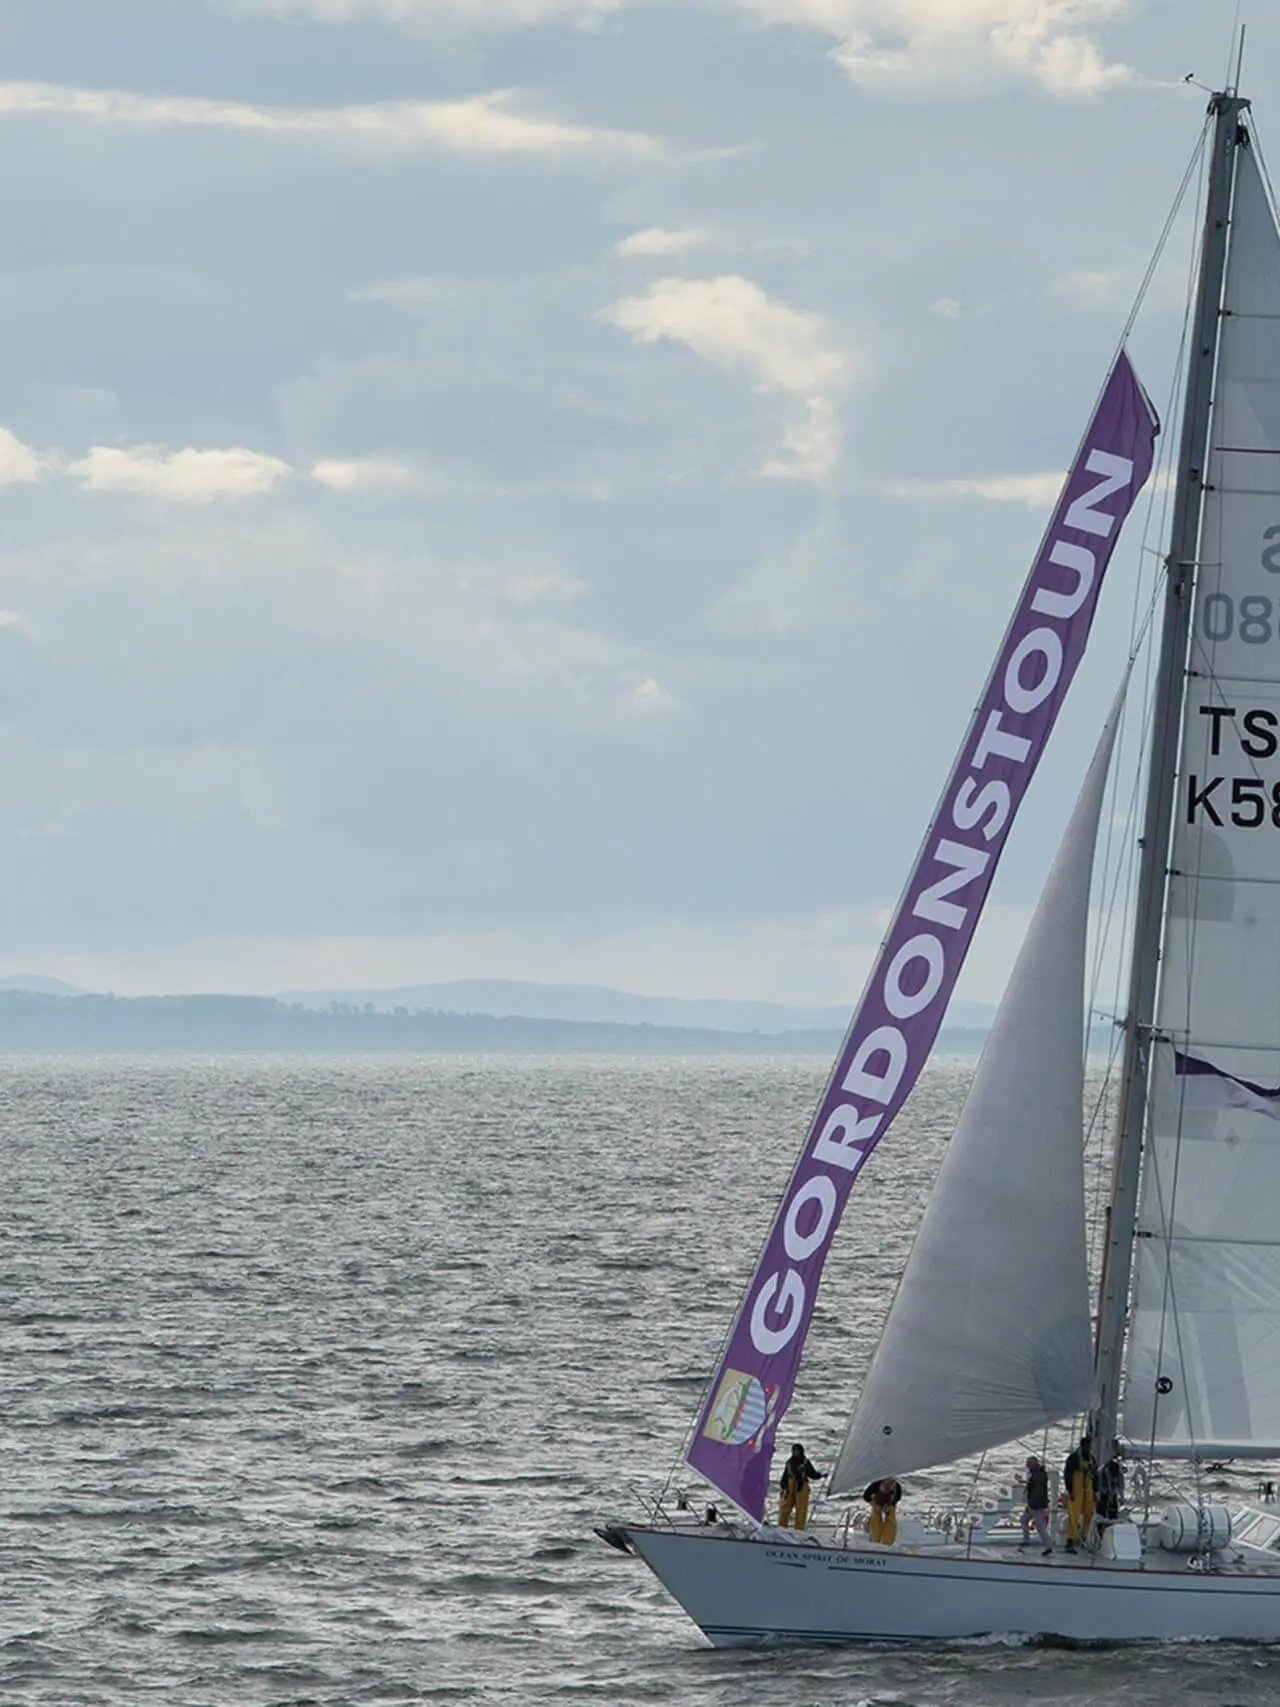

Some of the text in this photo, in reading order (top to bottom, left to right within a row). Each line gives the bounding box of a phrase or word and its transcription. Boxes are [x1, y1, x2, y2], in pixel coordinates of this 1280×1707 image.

[1199, 705, 1279, 758] TS
[750, 448, 1134, 1355] GORDONSTOUN
[765, 1550, 798, 1559] OCEAN
[802, 1553, 833, 1562] SPIRIT
[836, 1555, 849, 1563] OF
